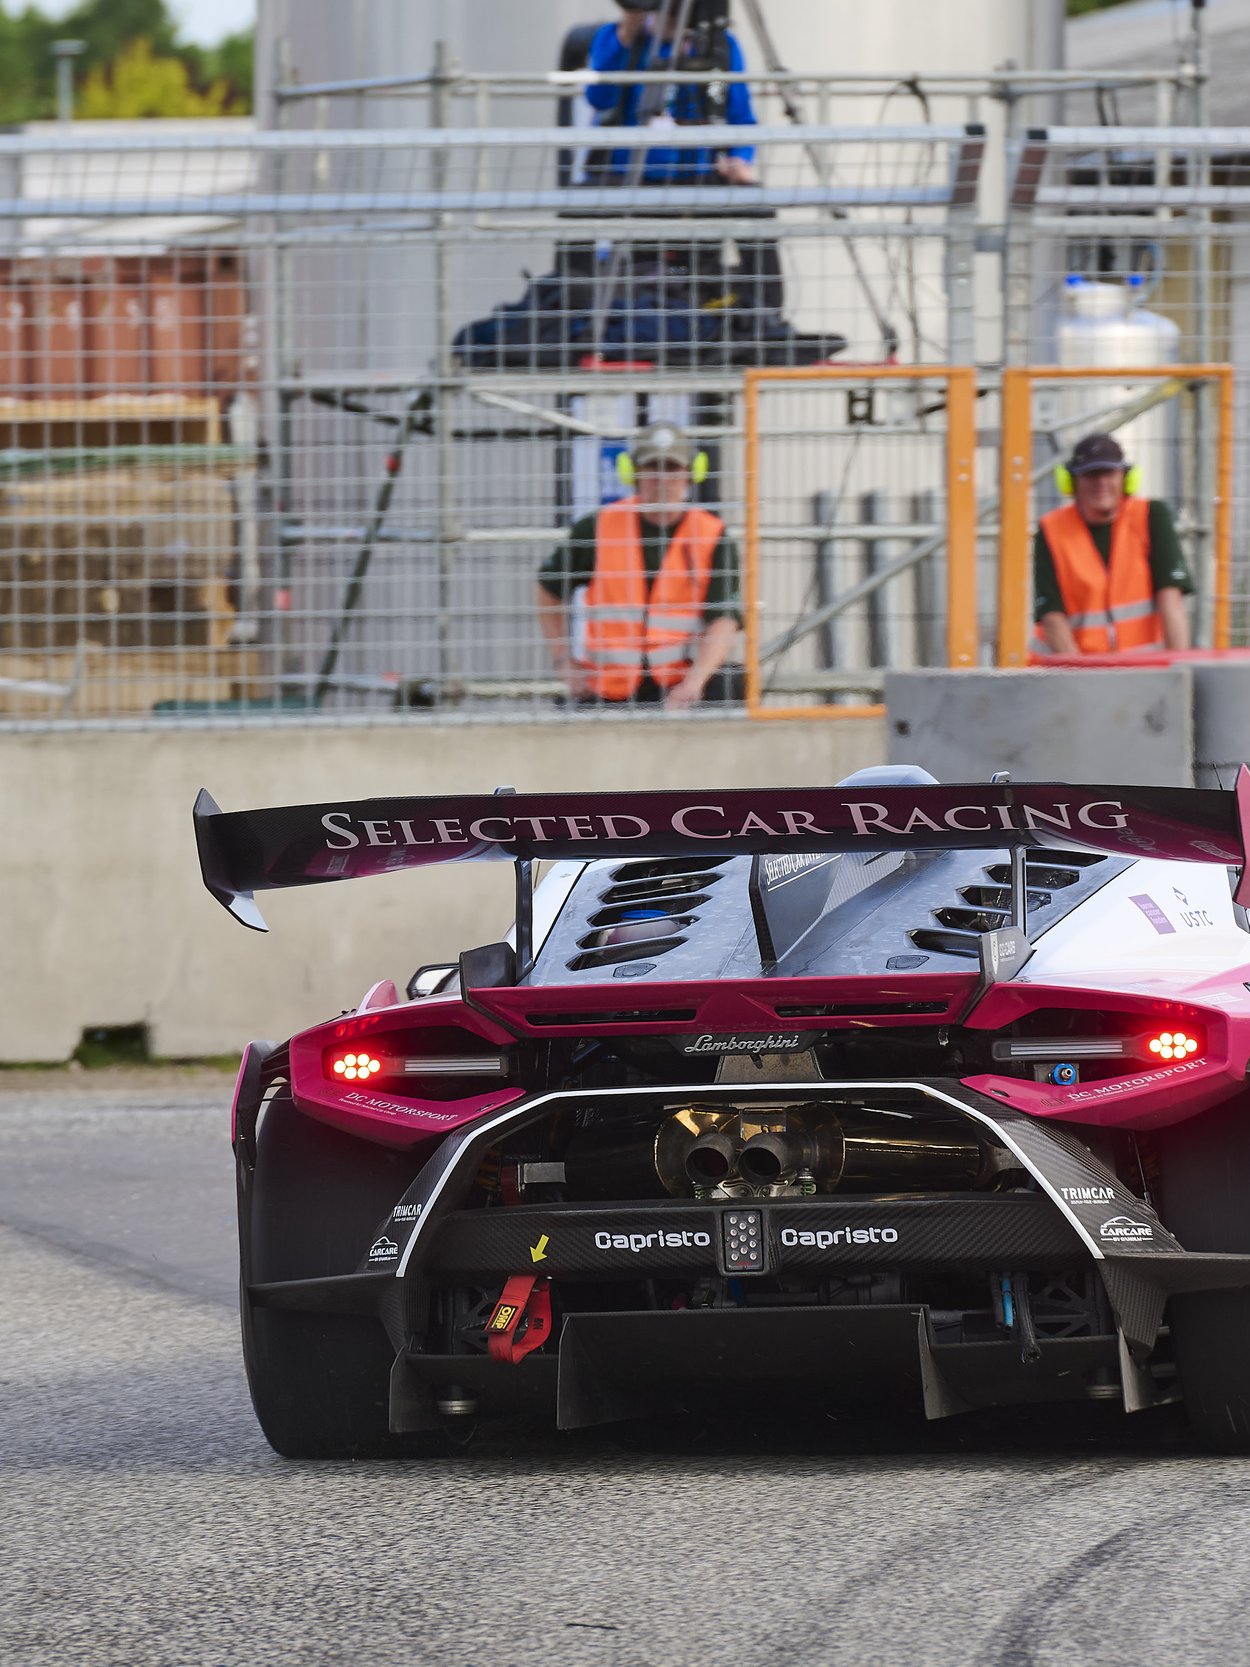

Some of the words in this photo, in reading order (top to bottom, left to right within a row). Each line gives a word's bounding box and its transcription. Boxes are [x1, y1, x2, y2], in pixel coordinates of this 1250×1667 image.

[320, 812, 650, 850] SELECTED
[671, 805, 836, 839] CAR
[841, 802, 1129, 837] RACING
[1180, 910, 1213, 928] USTC
[684, 1034, 799, 1053] Lamborghini
[1068, 1092, 1092, 1100] DC
[1093, 1058, 1207, 1093] MOTORSPORT
[346, 1092, 368, 1102] DC
[367, 1098, 459, 1121] MOTORSPORT
[1061, 1187, 1115, 1200] TRIMCAR
[393, 1203, 422, 1218] TRIMCAR
[594, 1230, 711, 1252] Capristo
[780, 1227, 898, 1249] Capristo
[1100, 1227, 1153, 1236] CARCARE
[370, 1246, 398, 1257] CARCARE
[496, 1306, 512, 1329] OMP
